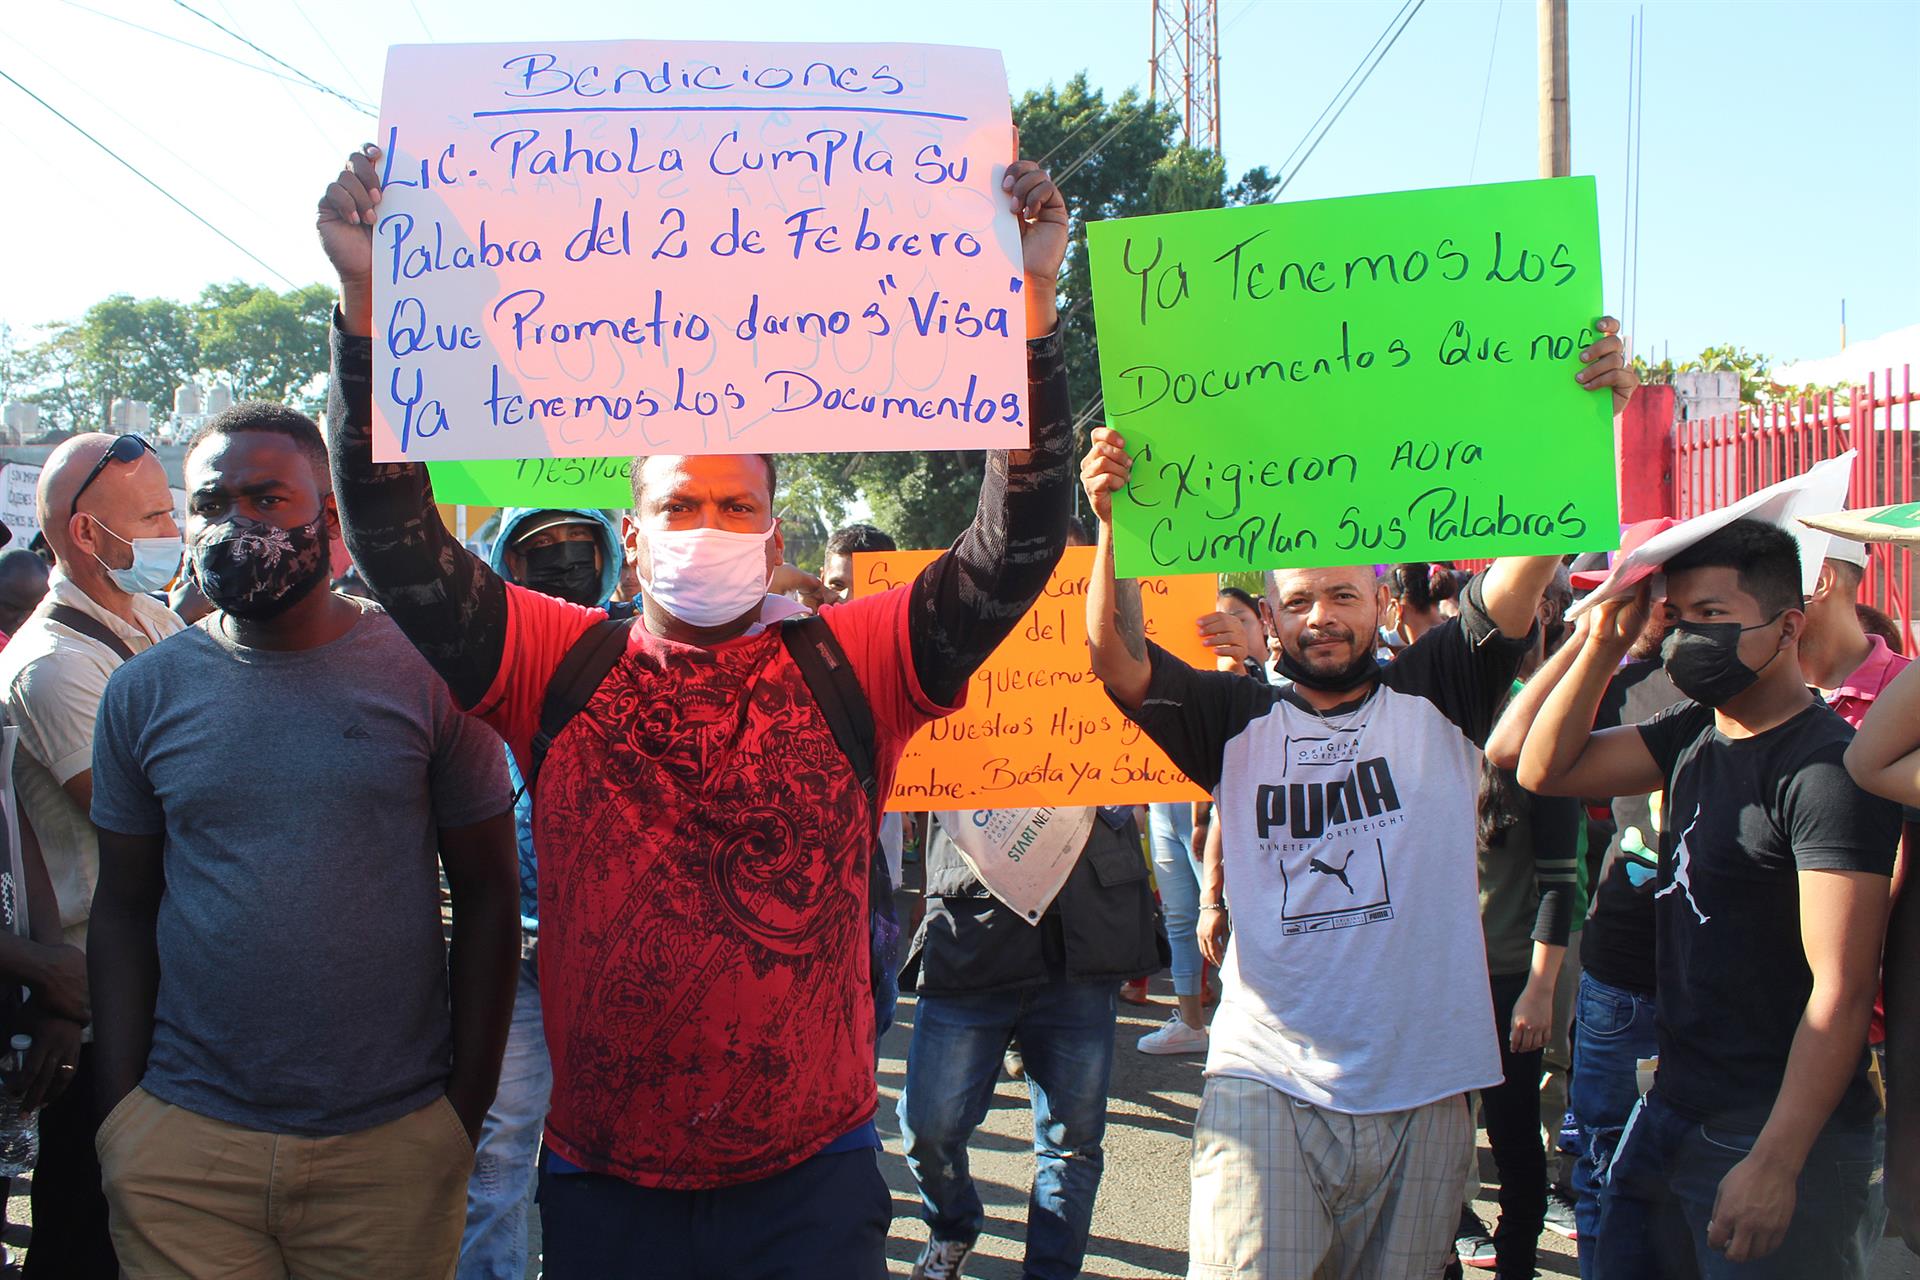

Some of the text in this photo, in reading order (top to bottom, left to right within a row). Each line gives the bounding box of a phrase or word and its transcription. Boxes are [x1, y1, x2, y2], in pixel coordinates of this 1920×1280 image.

[503, 53, 904, 98] Bendiciones
[565, 199, 631, 262] del
[652, 209, 687, 259] 2
[710, 208, 767, 256] de
[785, 207, 982, 259] Febrero
[1124, 229, 1577, 326] Ya Tenemos Los
[388, 297, 481, 360] Que
[494, 289, 711, 352] Prometio
[1110, 321, 1412, 417] Documentos
[1439, 320, 1514, 366] Que
[391, 366, 450, 453] Ya
[485, 364, 660, 428] tenemos
[1026, 609, 1065, 645] del
[1050, 707, 1111, 745] Hijos
[1111, 753, 1191, 784] Solucio
[1256, 757, 1401, 840] PUMA
[1007, 806, 1056, 862] START NET
